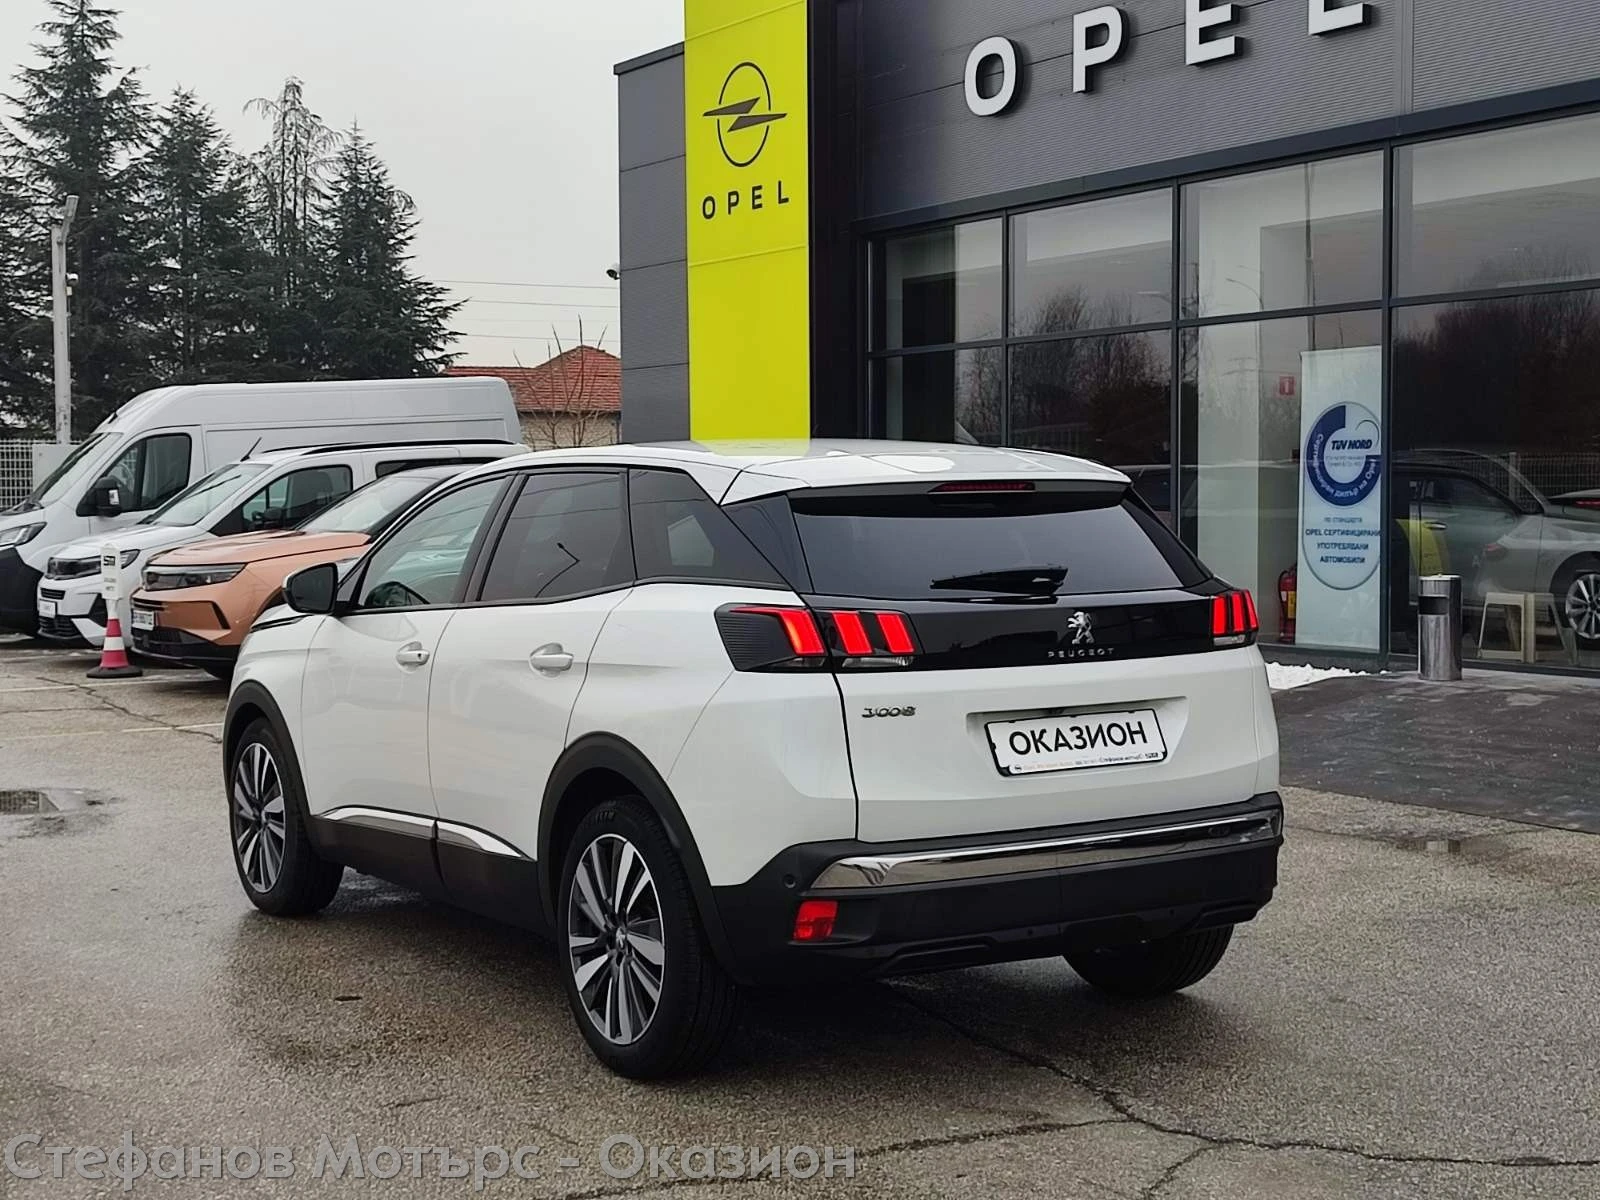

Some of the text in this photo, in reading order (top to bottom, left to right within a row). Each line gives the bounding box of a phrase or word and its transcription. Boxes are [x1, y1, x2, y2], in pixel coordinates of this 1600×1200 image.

[702, 180, 789, 220] OPEL
[1347, 439, 1373, 449] NORD
[1305, 528, 1323, 537] OPEL
[1047, 647, 1115, 658] PEUGEOT
[1008, 721, 1149, 756] ОКАЗИОН
